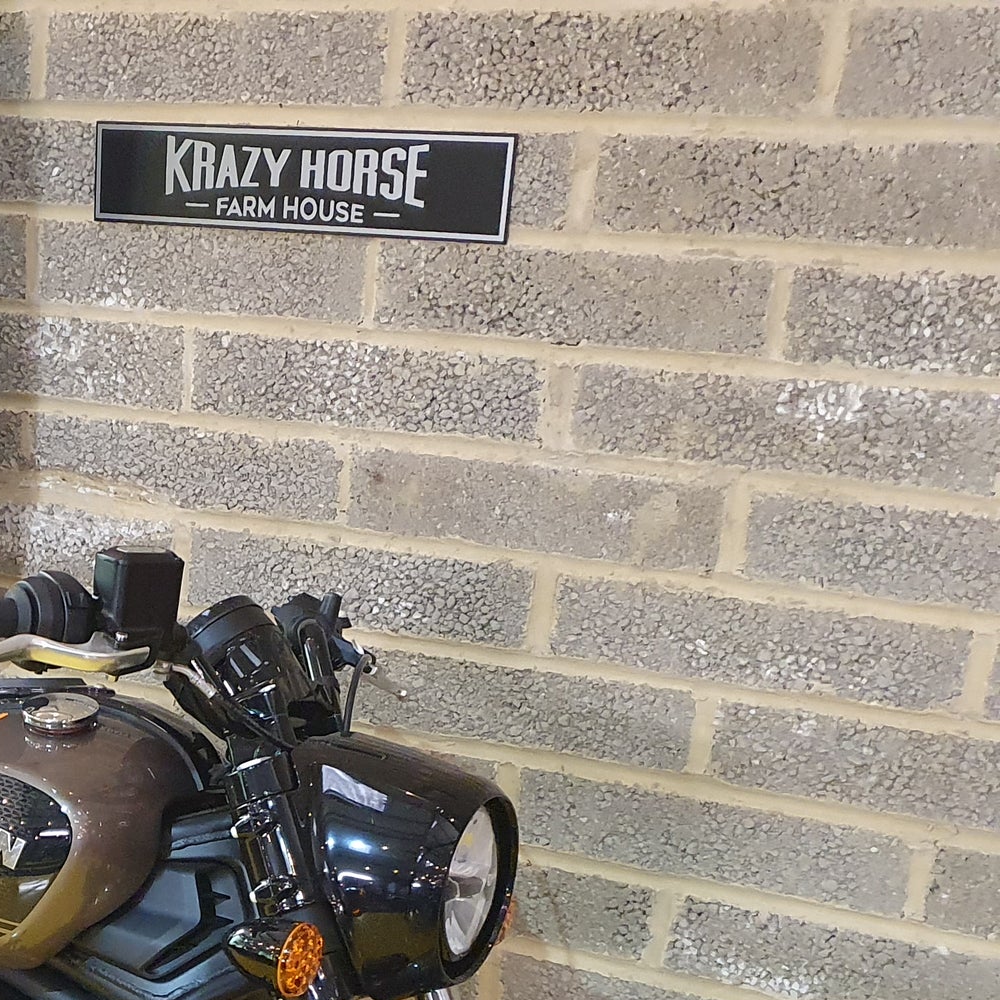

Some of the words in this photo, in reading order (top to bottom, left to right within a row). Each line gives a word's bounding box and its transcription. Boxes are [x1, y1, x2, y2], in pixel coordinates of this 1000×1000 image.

[165, 134, 292, 196] KRAZY
[299, 143, 432, 209] HORSE
[215, 196, 275, 220] FARM
[283, 197, 364, 224] HOUSE
